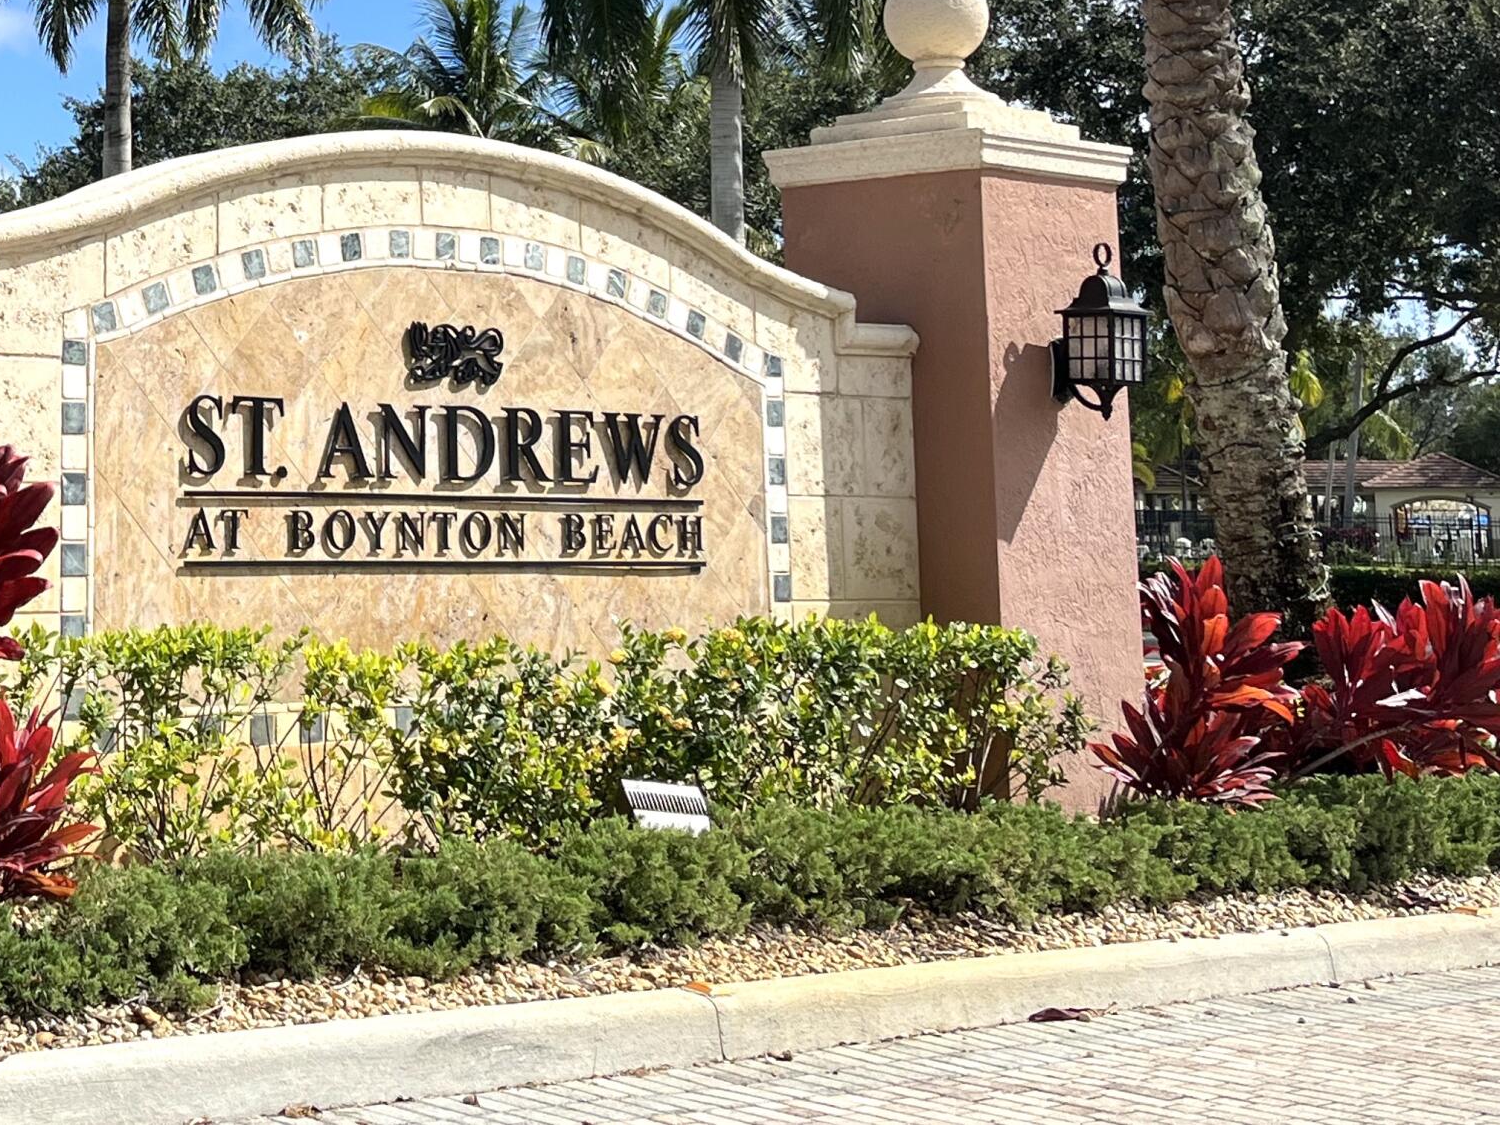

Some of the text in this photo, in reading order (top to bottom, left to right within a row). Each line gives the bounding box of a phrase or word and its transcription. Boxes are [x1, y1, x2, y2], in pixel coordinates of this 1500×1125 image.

[187, 394, 704, 486] ST. ANDREWS
[186, 507, 704, 552] AT BOYNTON BEACH
